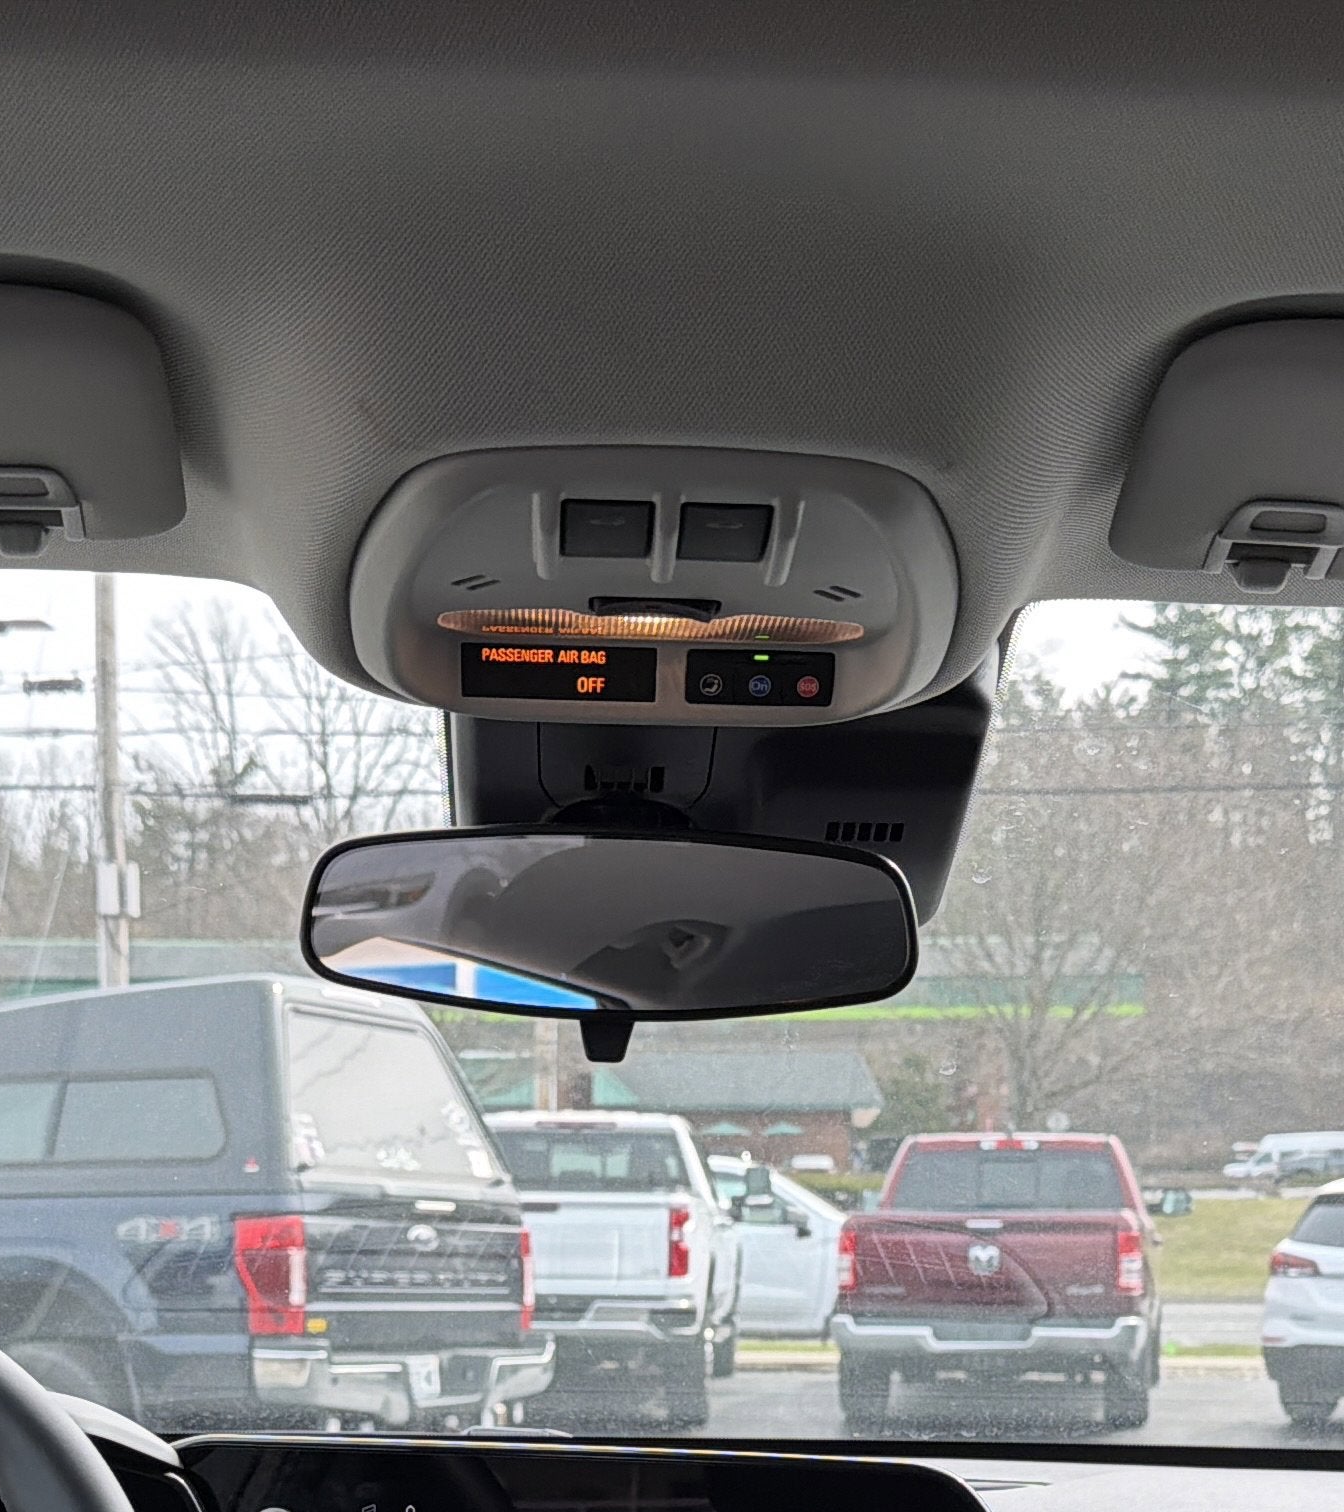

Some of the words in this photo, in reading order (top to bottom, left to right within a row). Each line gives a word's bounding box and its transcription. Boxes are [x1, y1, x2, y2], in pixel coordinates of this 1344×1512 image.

[481, 648, 554, 663] PASSENGER
[557, 649, 580, 664] AIR
[580, 650, 607, 665] BAG
[576, 676, 606, 694] OFF
[797, 679, 818, 692] SOS
